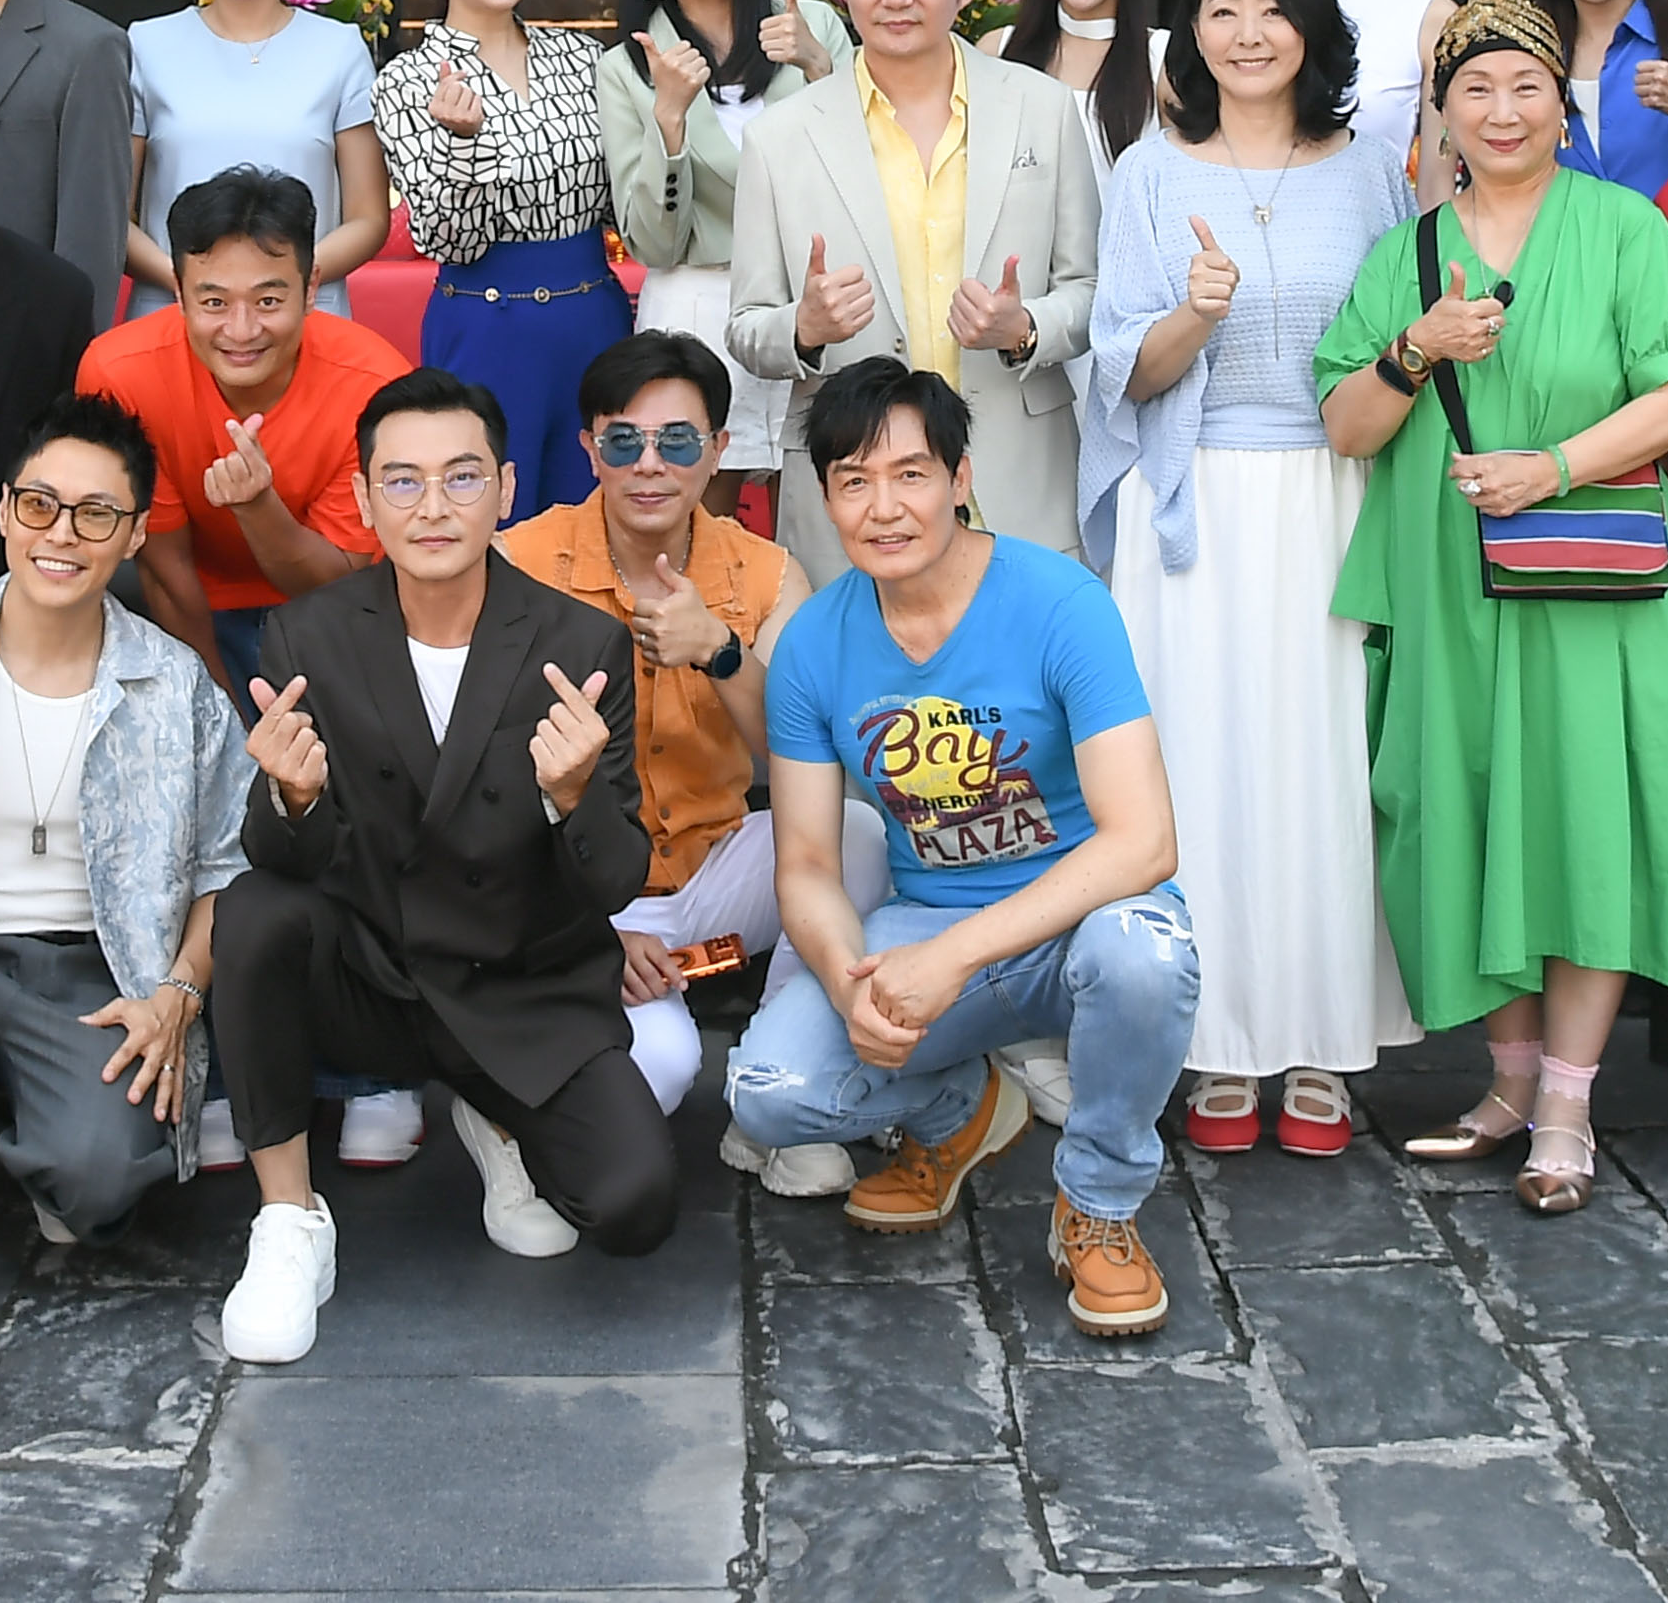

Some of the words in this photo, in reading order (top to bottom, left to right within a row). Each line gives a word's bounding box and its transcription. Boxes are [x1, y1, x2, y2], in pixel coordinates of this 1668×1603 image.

[928, 706, 1002, 729] KARL'S
[857, 708, 1029, 792] Bay
[913, 807, 1053, 861] PLAZA
